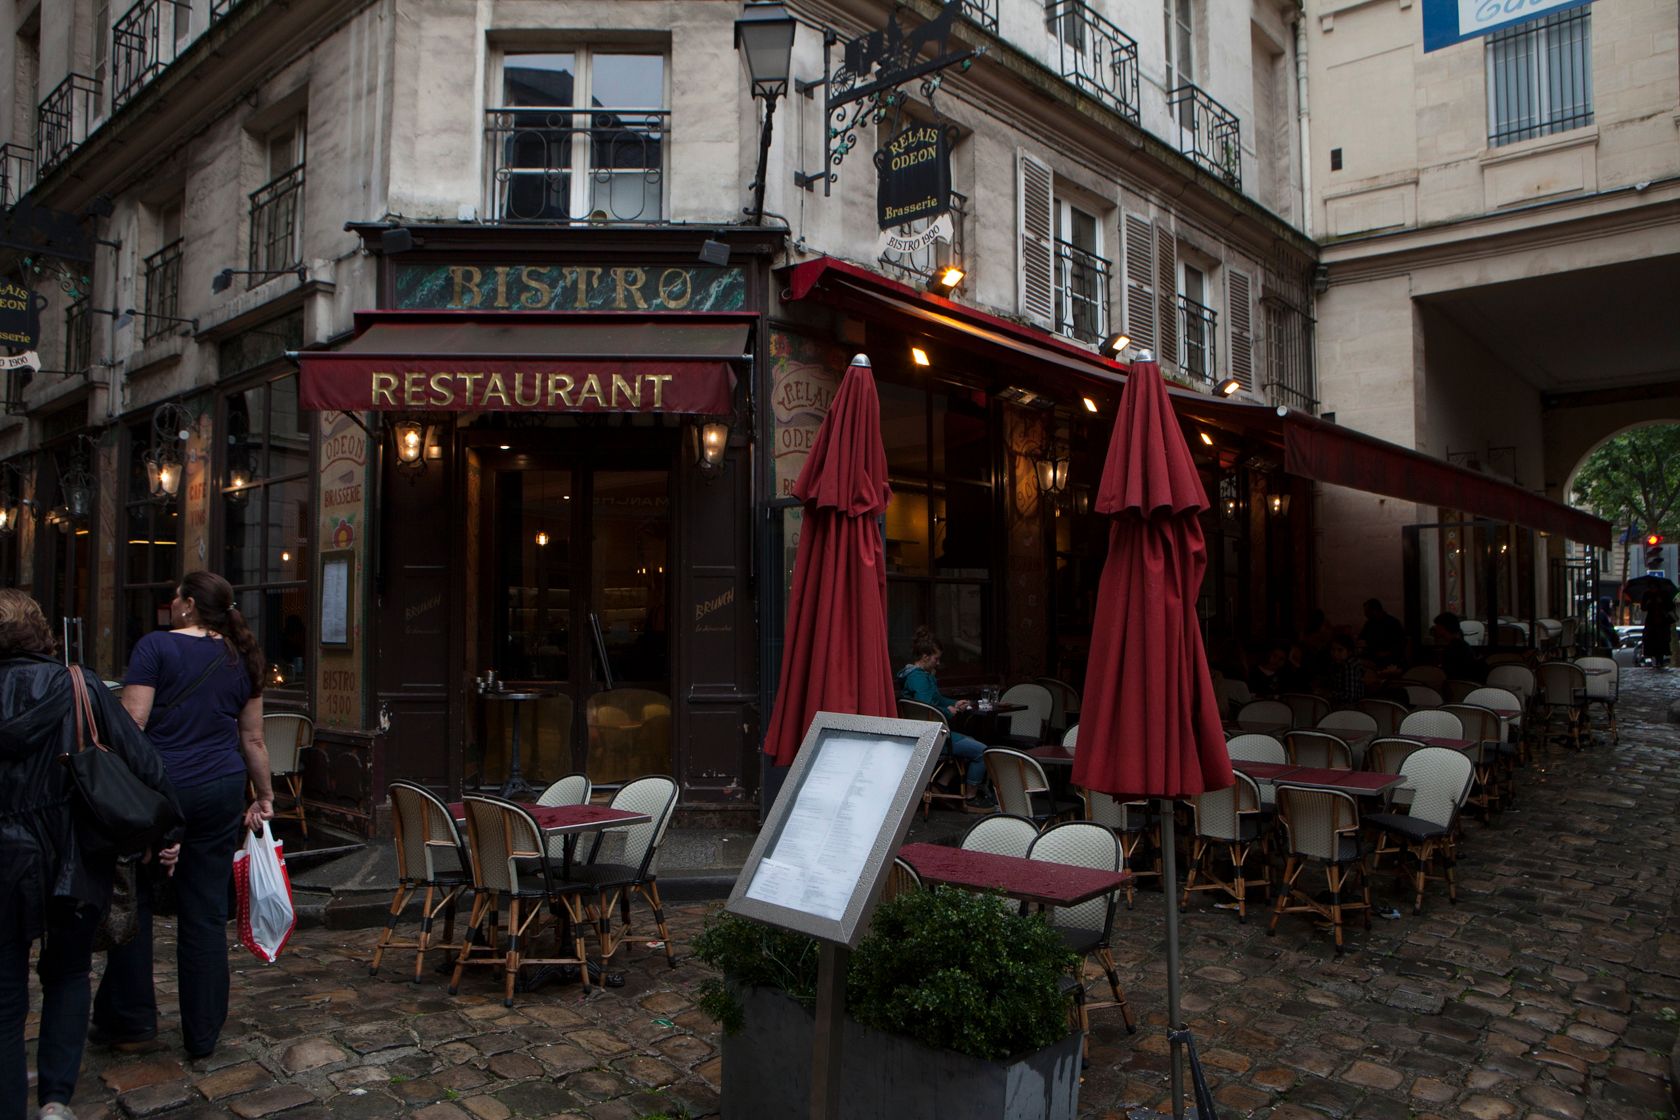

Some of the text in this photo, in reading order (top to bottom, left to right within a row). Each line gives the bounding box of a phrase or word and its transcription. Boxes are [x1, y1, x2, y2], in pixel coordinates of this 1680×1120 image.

[889, 128, 938, 155] RELAIS
[891, 145, 937, 171] ODEON
[884, 195, 938, 220] Brasserie
[887, 224, 940, 251] BISTRO 1900
[448, 265, 692, 309] BISTRO
[8, 356, 28, 367] 1900
[371, 372, 673, 408] RESTAURANT
[326, 435, 365, 460] ODEON
[324, 484, 362, 508] BRASSERIE
[695, 586, 735, 621] BRUNCH
[322, 670, 356, 692] BISTRO
[326, 694, 352, 714] 1900
